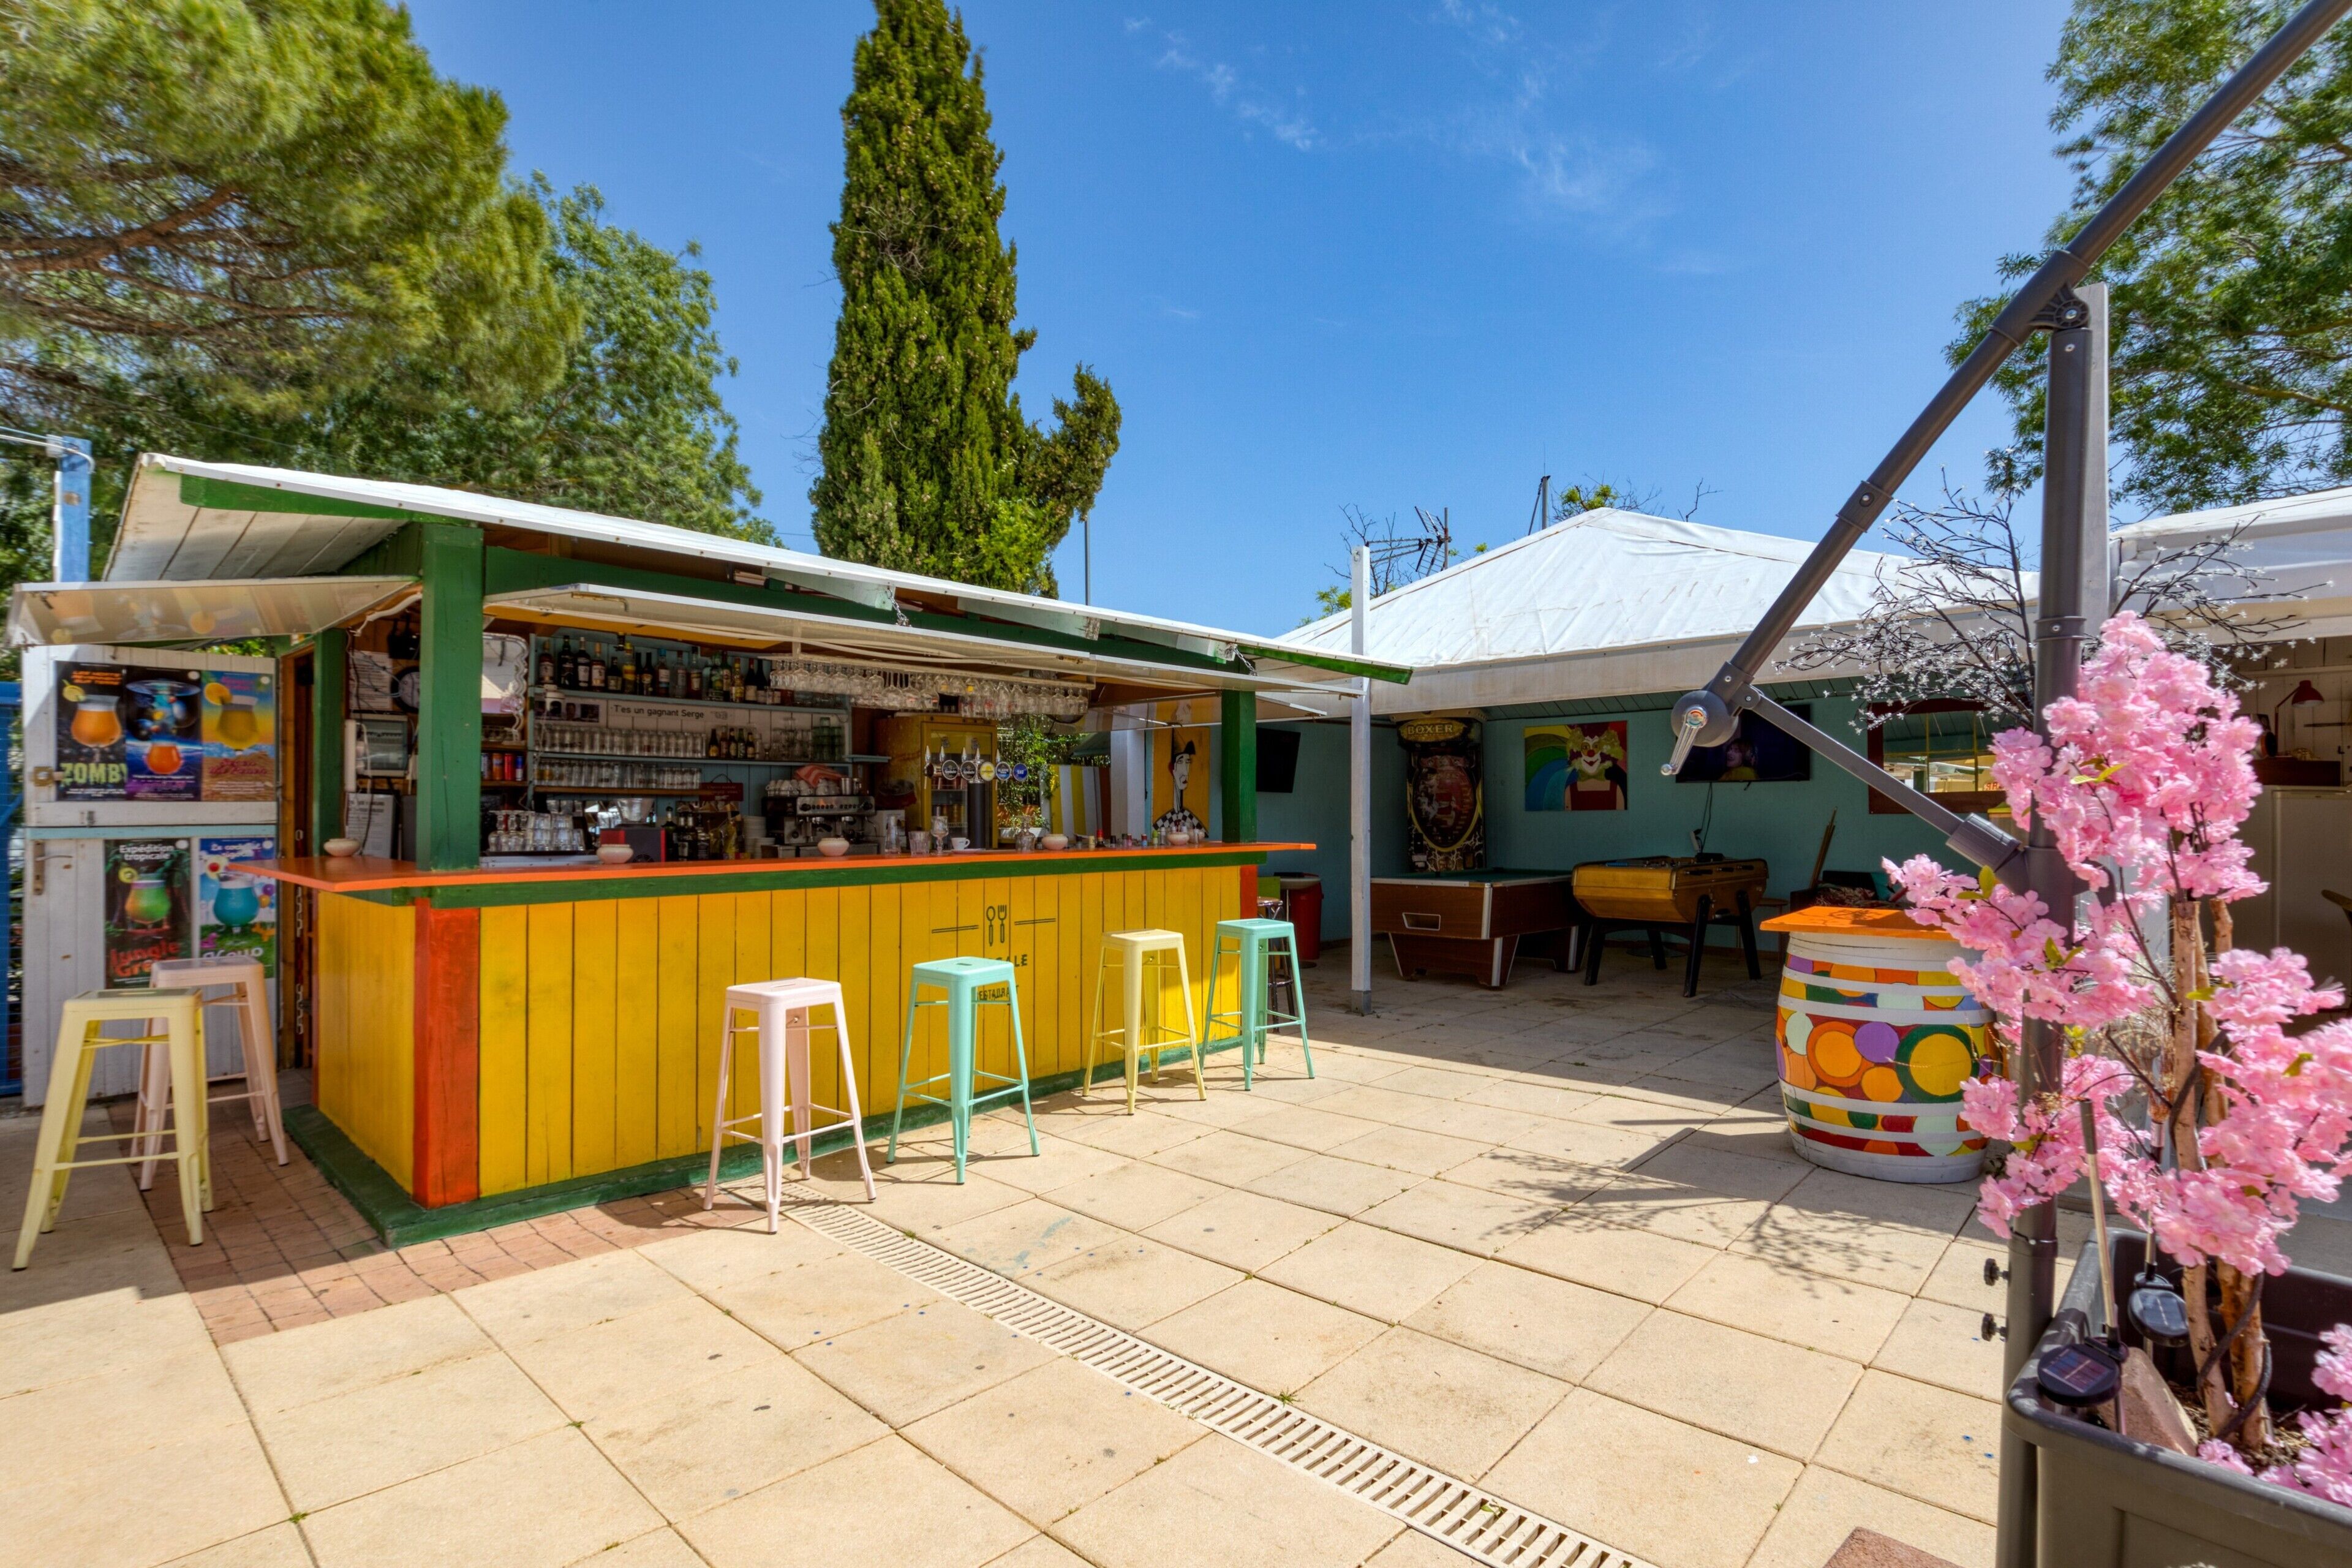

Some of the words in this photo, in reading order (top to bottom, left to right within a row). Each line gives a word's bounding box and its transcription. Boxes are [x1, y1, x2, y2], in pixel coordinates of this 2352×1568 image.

[647, 708, 679, 717] gagnant
[681, 709, 705, 720] Serge
[1407, 724, 1453, 734] BOXER
